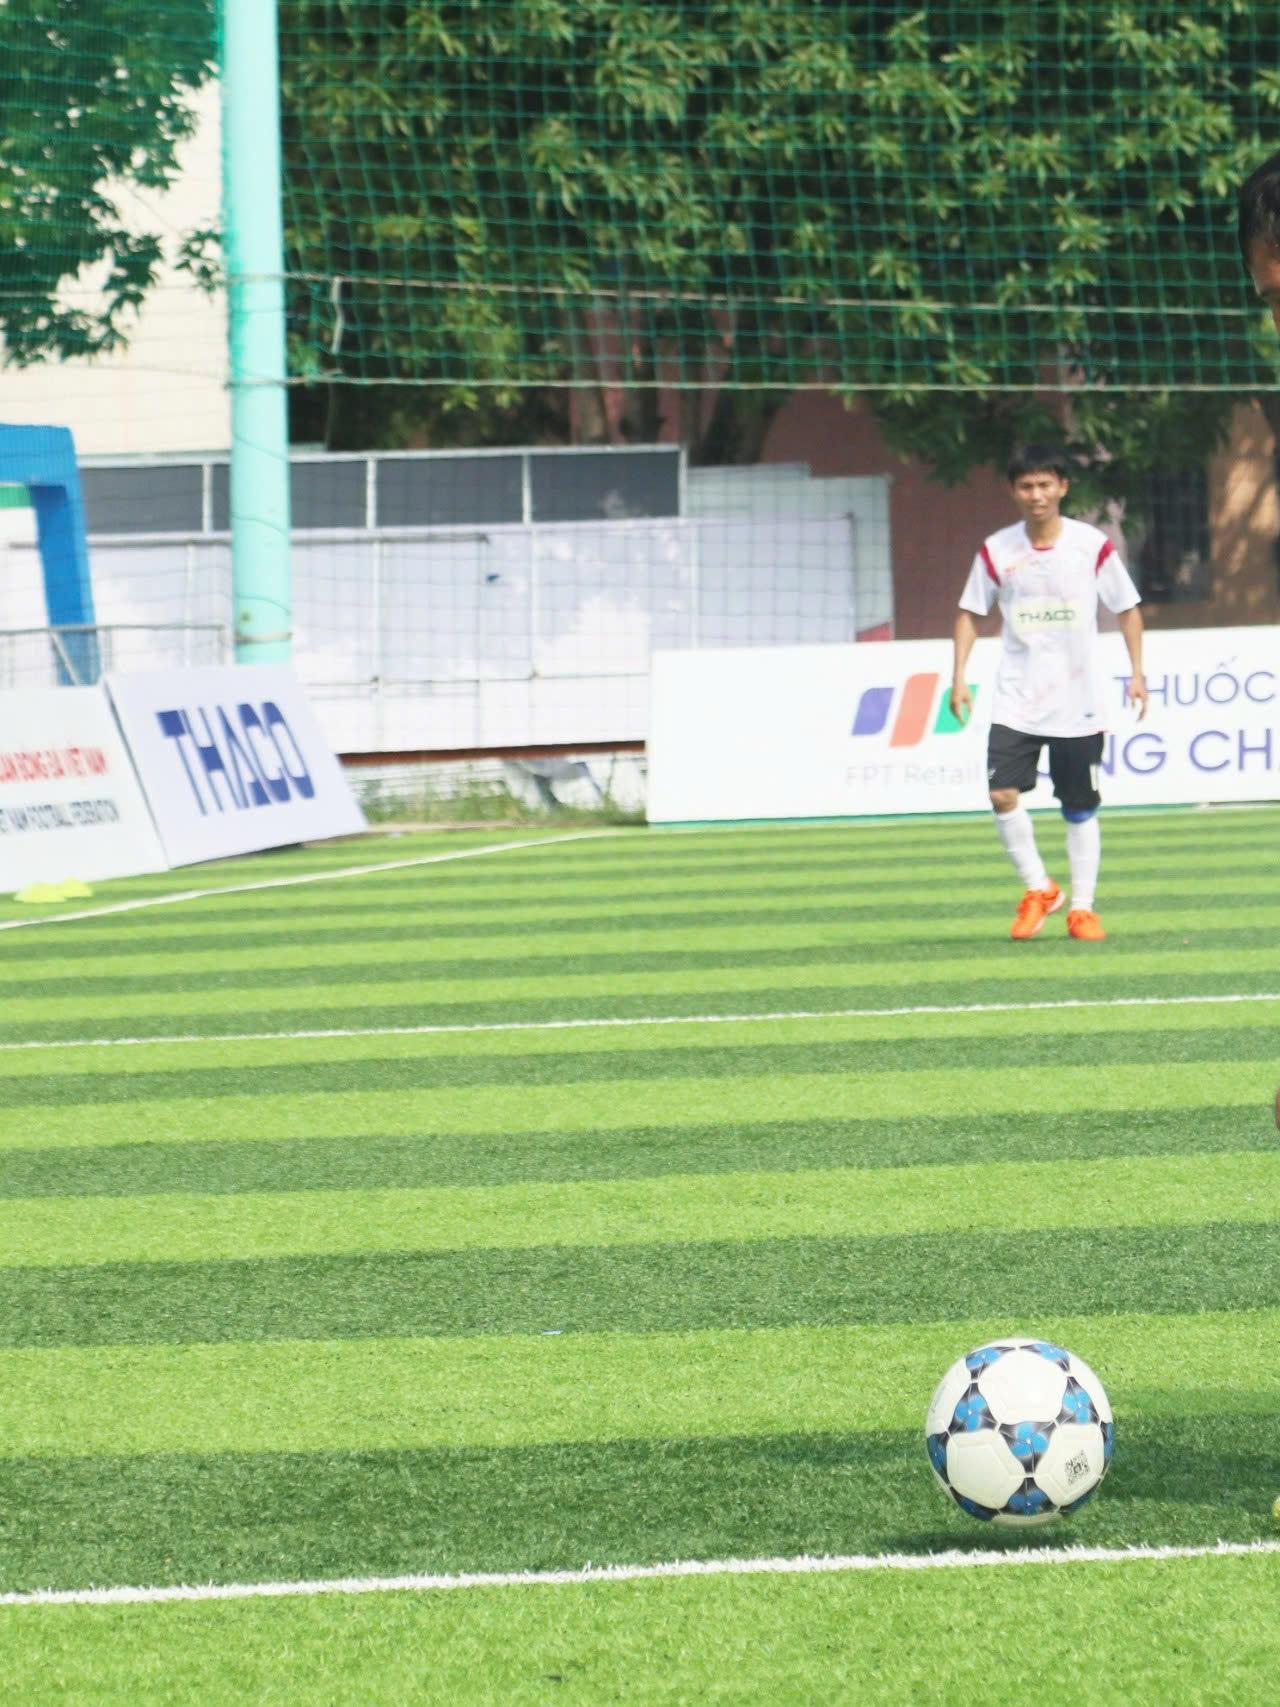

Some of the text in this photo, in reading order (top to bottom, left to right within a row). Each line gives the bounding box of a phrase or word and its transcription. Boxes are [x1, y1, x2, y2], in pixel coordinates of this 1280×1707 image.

[1018, 608, 1076, 624] THACO
[1113, 655, 1277, 708] THUỐC
[155, 701, 315, 816] THACO
[844, 760, 982, 786] FPT Retail
